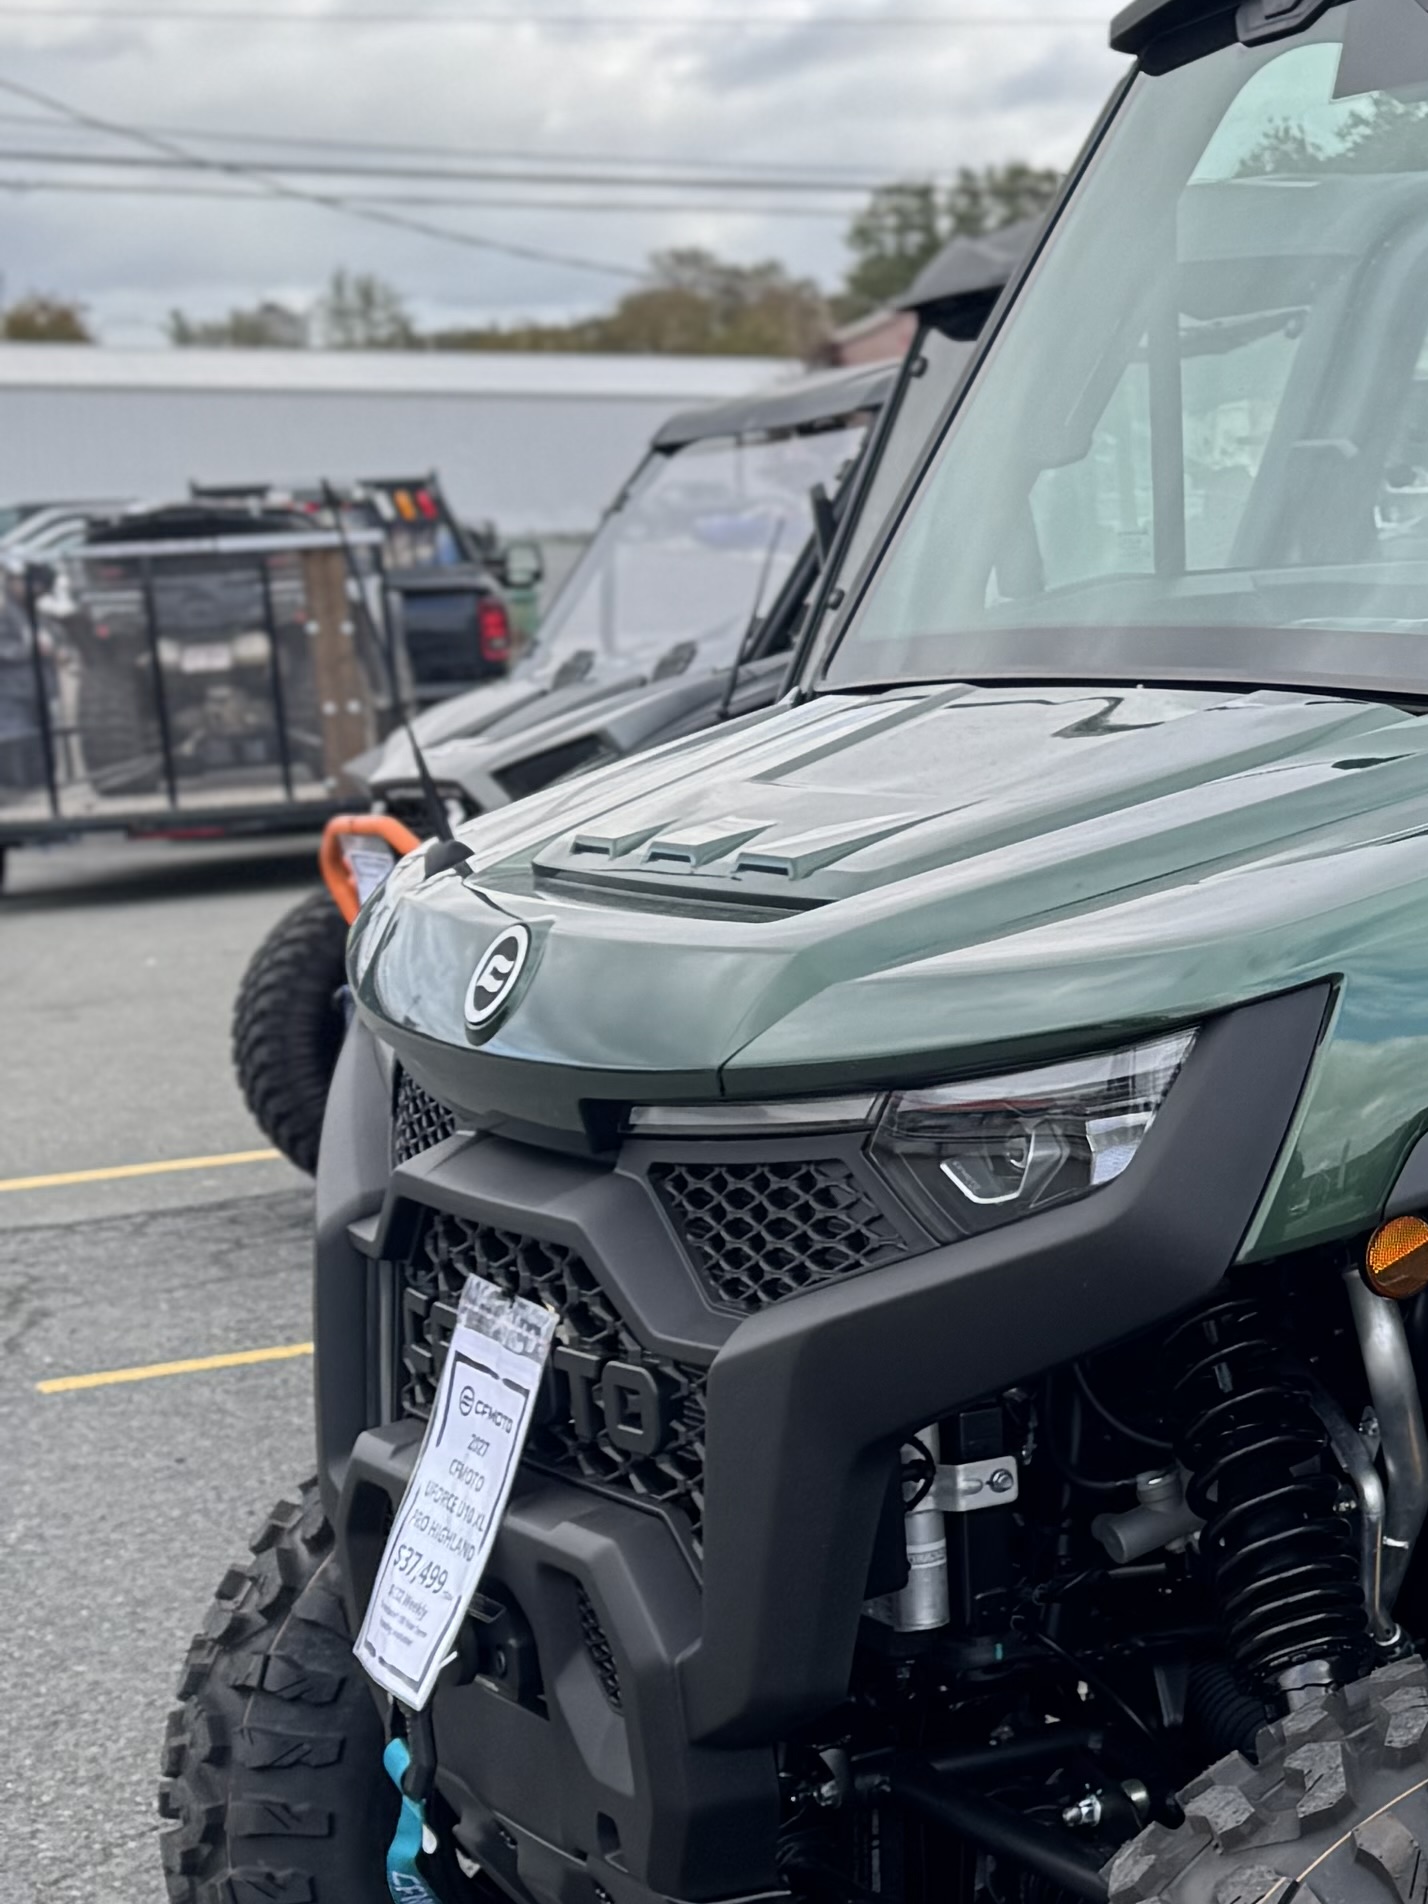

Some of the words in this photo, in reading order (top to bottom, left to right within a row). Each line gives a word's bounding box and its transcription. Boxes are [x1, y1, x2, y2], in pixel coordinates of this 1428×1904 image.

[403, 1287, 662, 1456] CFTO
[475, 1400, 513, 1433] CFMOTO
[449, 1459, 485, 1492] CFMOTO
[424, 1480, 459, 1514] UFORCE
[457, 1500, 475, 1525] U10
[473, 1513, 486, 1532] XL
[410, 1509, 430, 1532] PRO
[428, 1521, 475, 1563] HIGHLAND
[393, 1544, 448, 1594] $37,499
